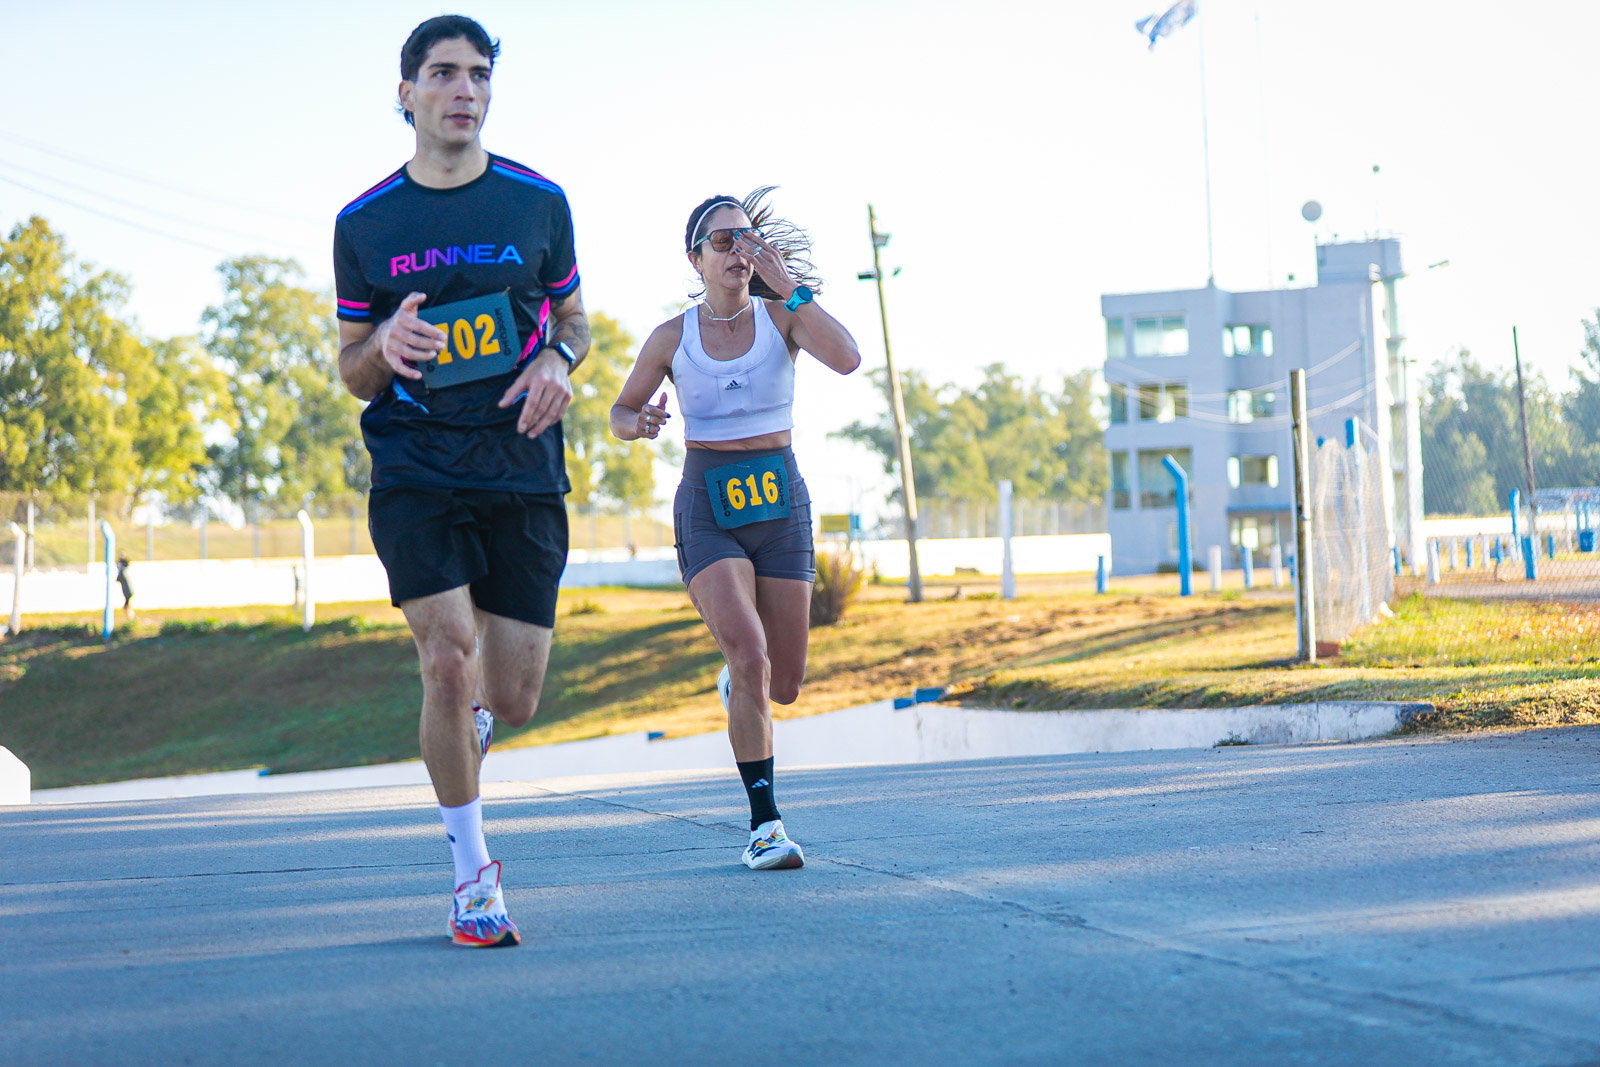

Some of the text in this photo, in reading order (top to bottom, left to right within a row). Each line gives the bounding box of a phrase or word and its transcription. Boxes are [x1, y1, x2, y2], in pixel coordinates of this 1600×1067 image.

[390, 243, 524, 277] RUNNEA
[715, 479, 731, 518] TIEMPO
[726, 470, 778, 511] 616
[775, 468, 785, 507] EXACTO
